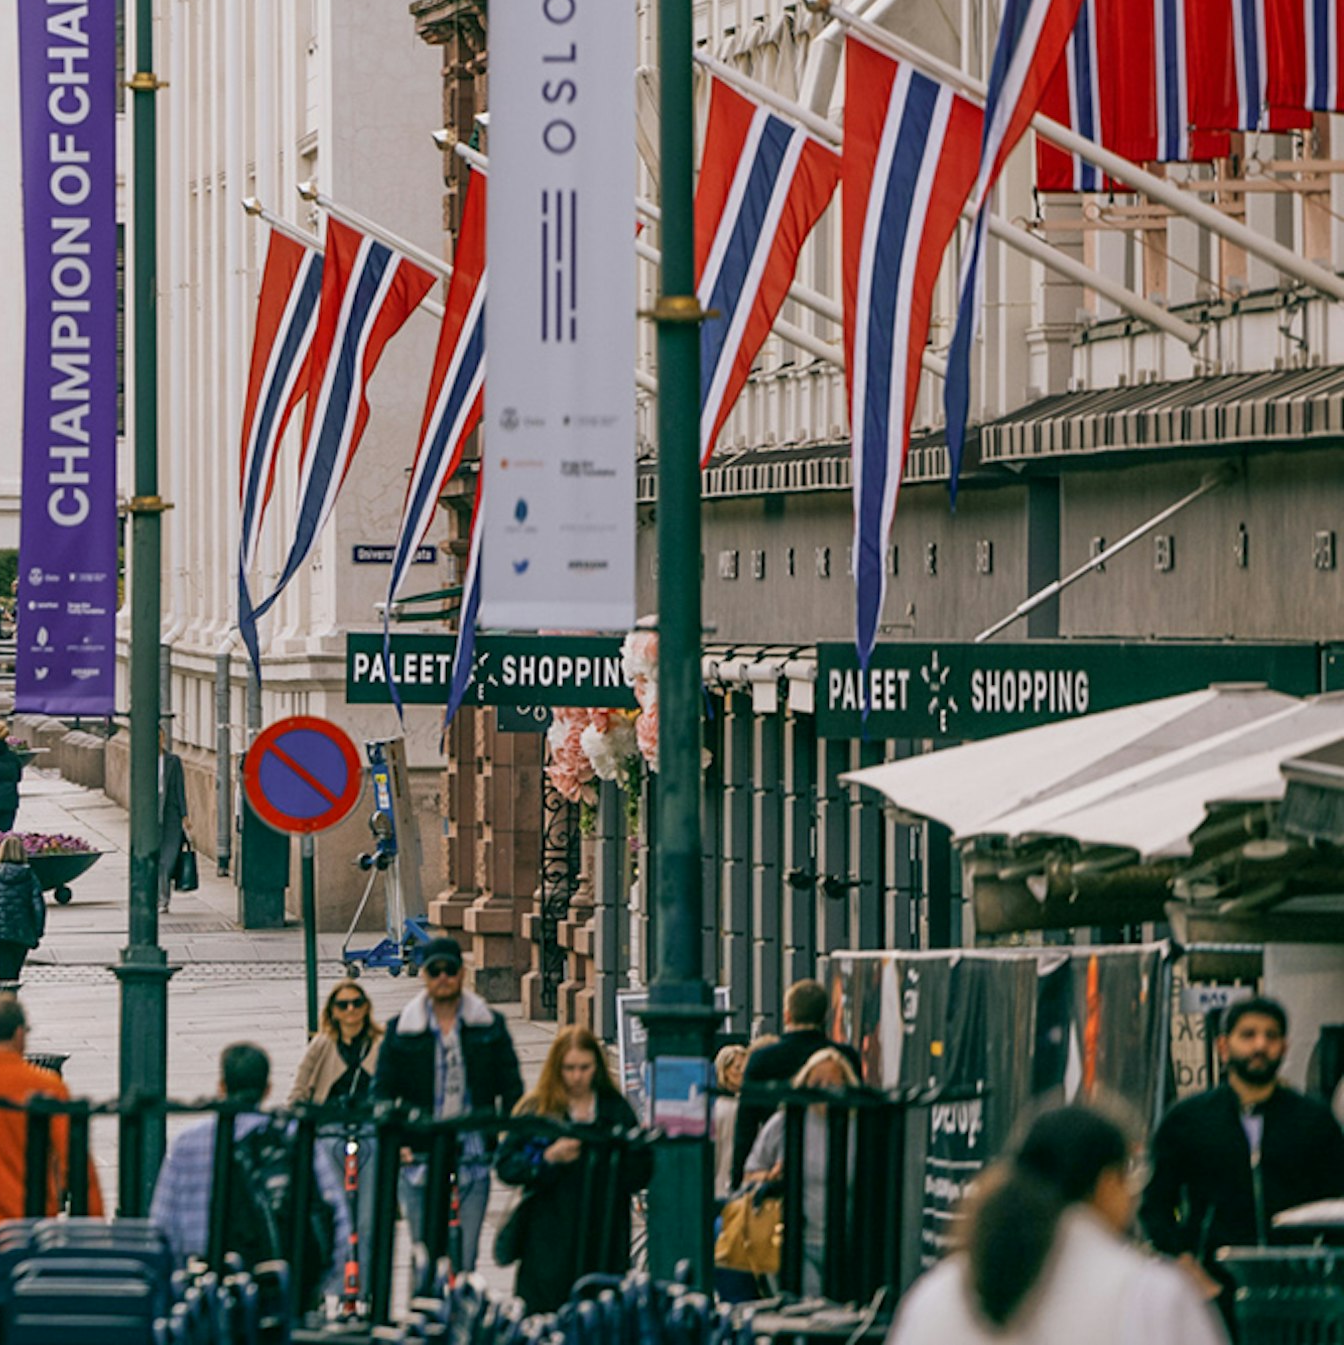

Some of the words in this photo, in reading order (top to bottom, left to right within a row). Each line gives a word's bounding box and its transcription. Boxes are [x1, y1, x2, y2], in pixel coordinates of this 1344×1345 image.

[49, 132, 90, 206] OF
[48, 217, 90, 526] CHAMPION
[353, 652, 452, 685] PALEET
[970, 669, 1090, 714] SHOPPING
